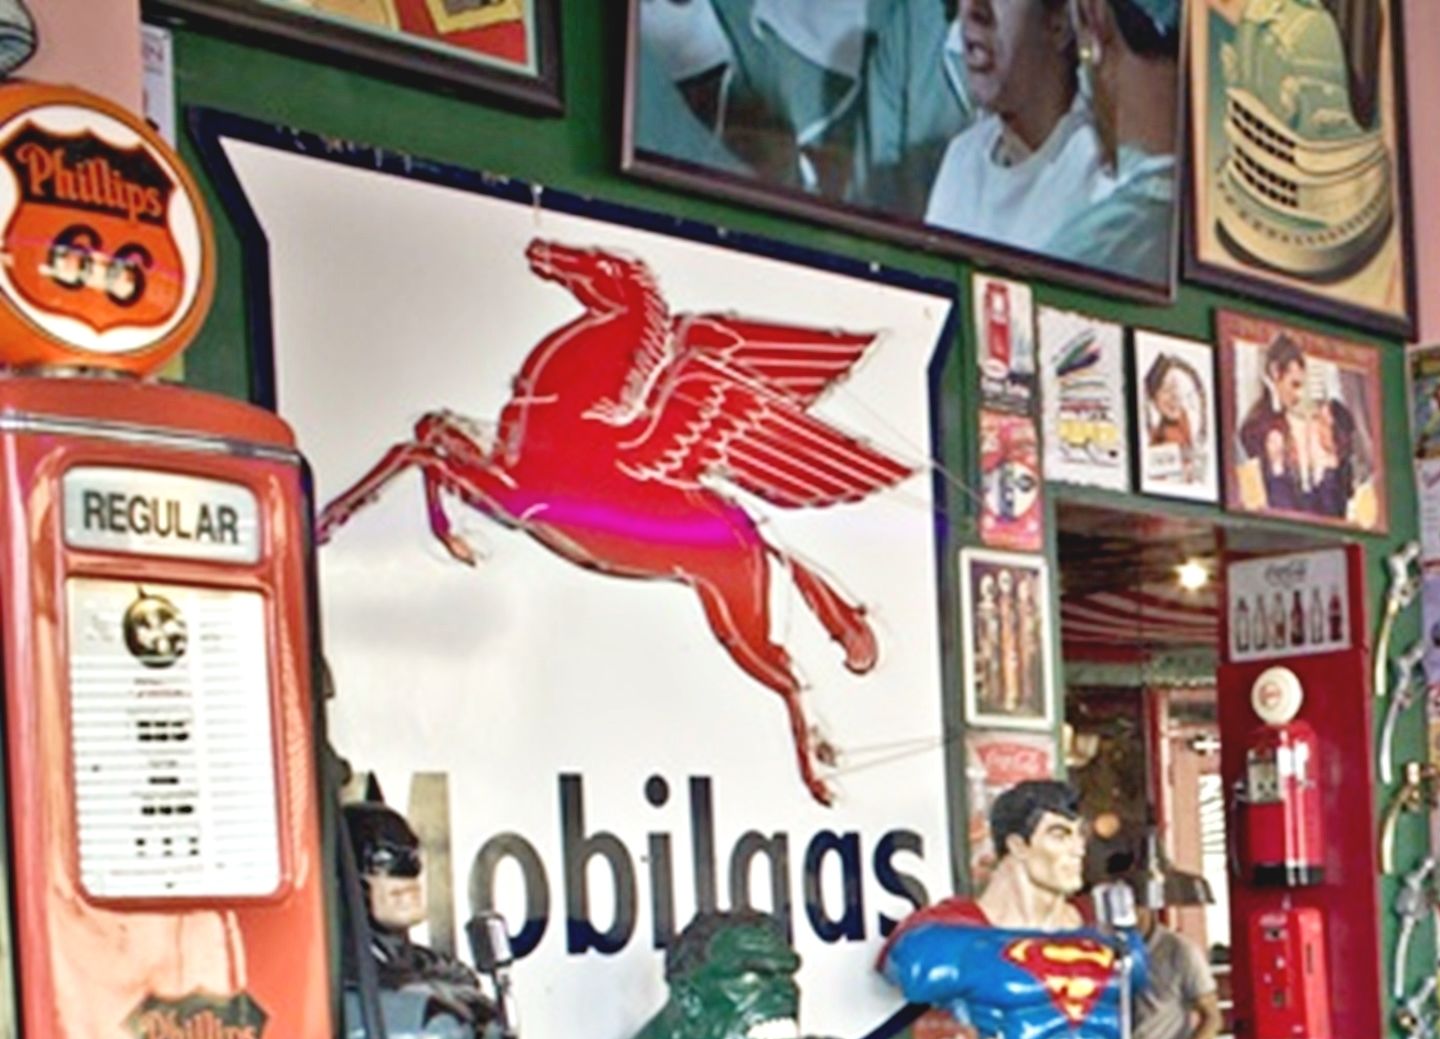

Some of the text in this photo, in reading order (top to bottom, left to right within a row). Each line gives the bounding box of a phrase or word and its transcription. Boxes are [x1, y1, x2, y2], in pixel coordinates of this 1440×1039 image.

[15, 142, 163, 223] Phillips
[47, 222, 153, 308] 66
[82, 490, 240, 545] REGULAR
